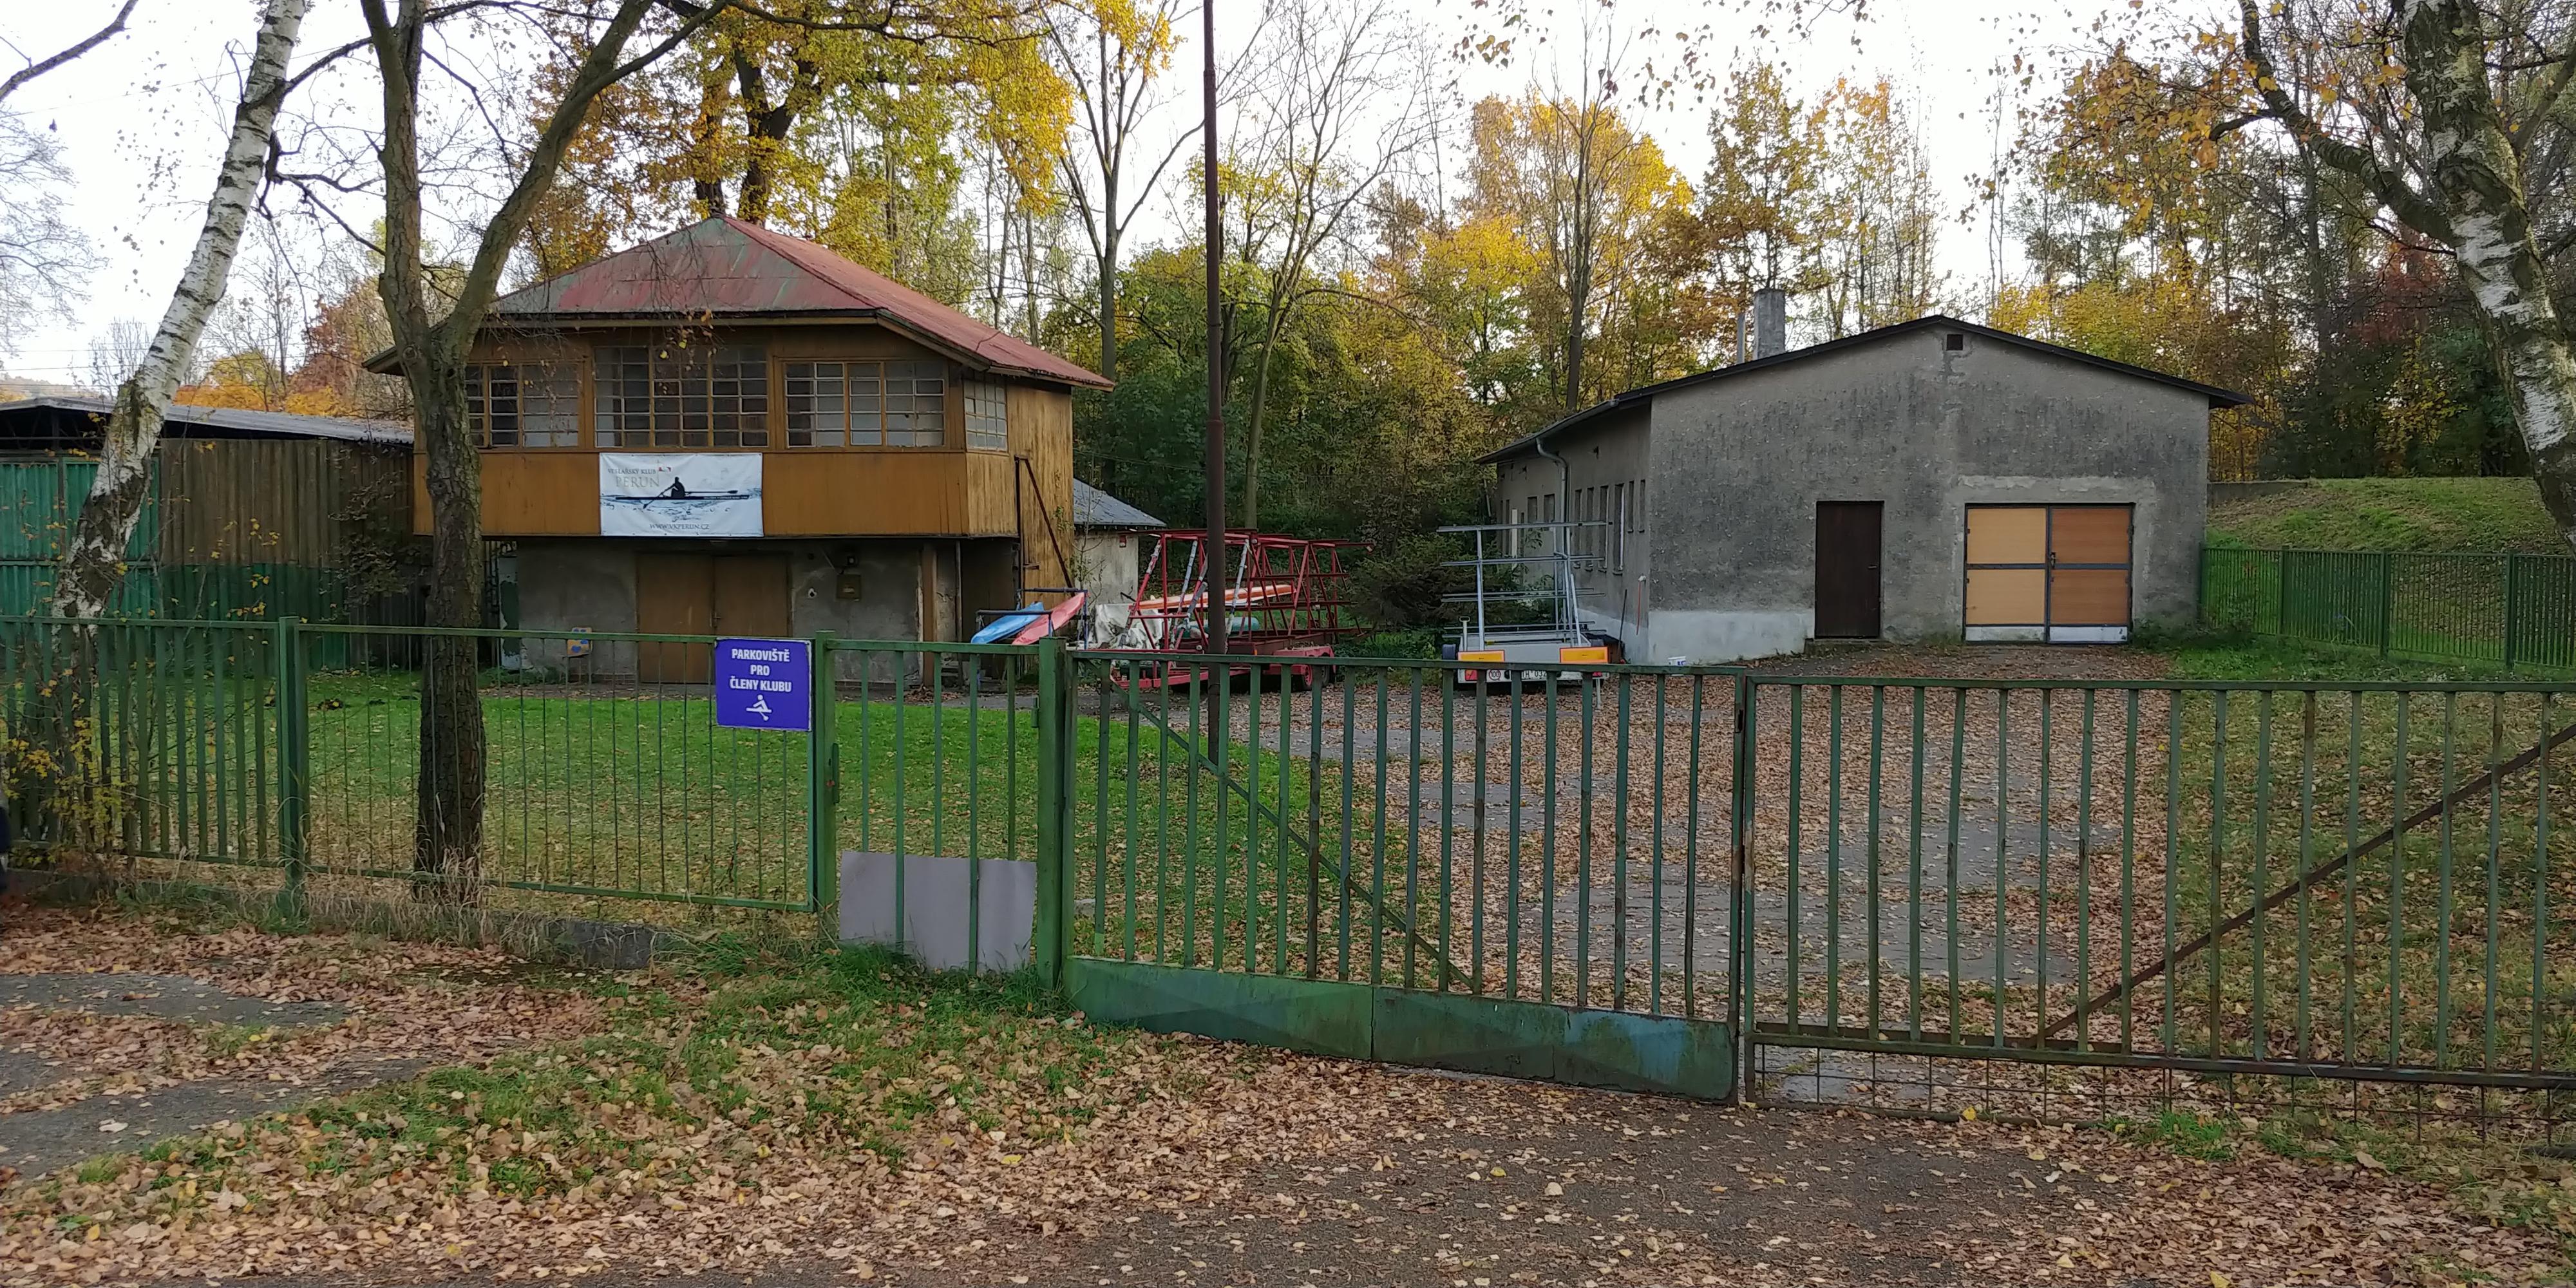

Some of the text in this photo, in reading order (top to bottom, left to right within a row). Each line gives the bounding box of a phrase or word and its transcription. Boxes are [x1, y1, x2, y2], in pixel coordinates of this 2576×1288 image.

[616, 477, 659, 488] PERUN
[732, 648, 790, 662] PARKOVIŠTĚ
[750, 665, 770, 676] PRO
[730, 676, 791, 692] ČLENY KLUBU
